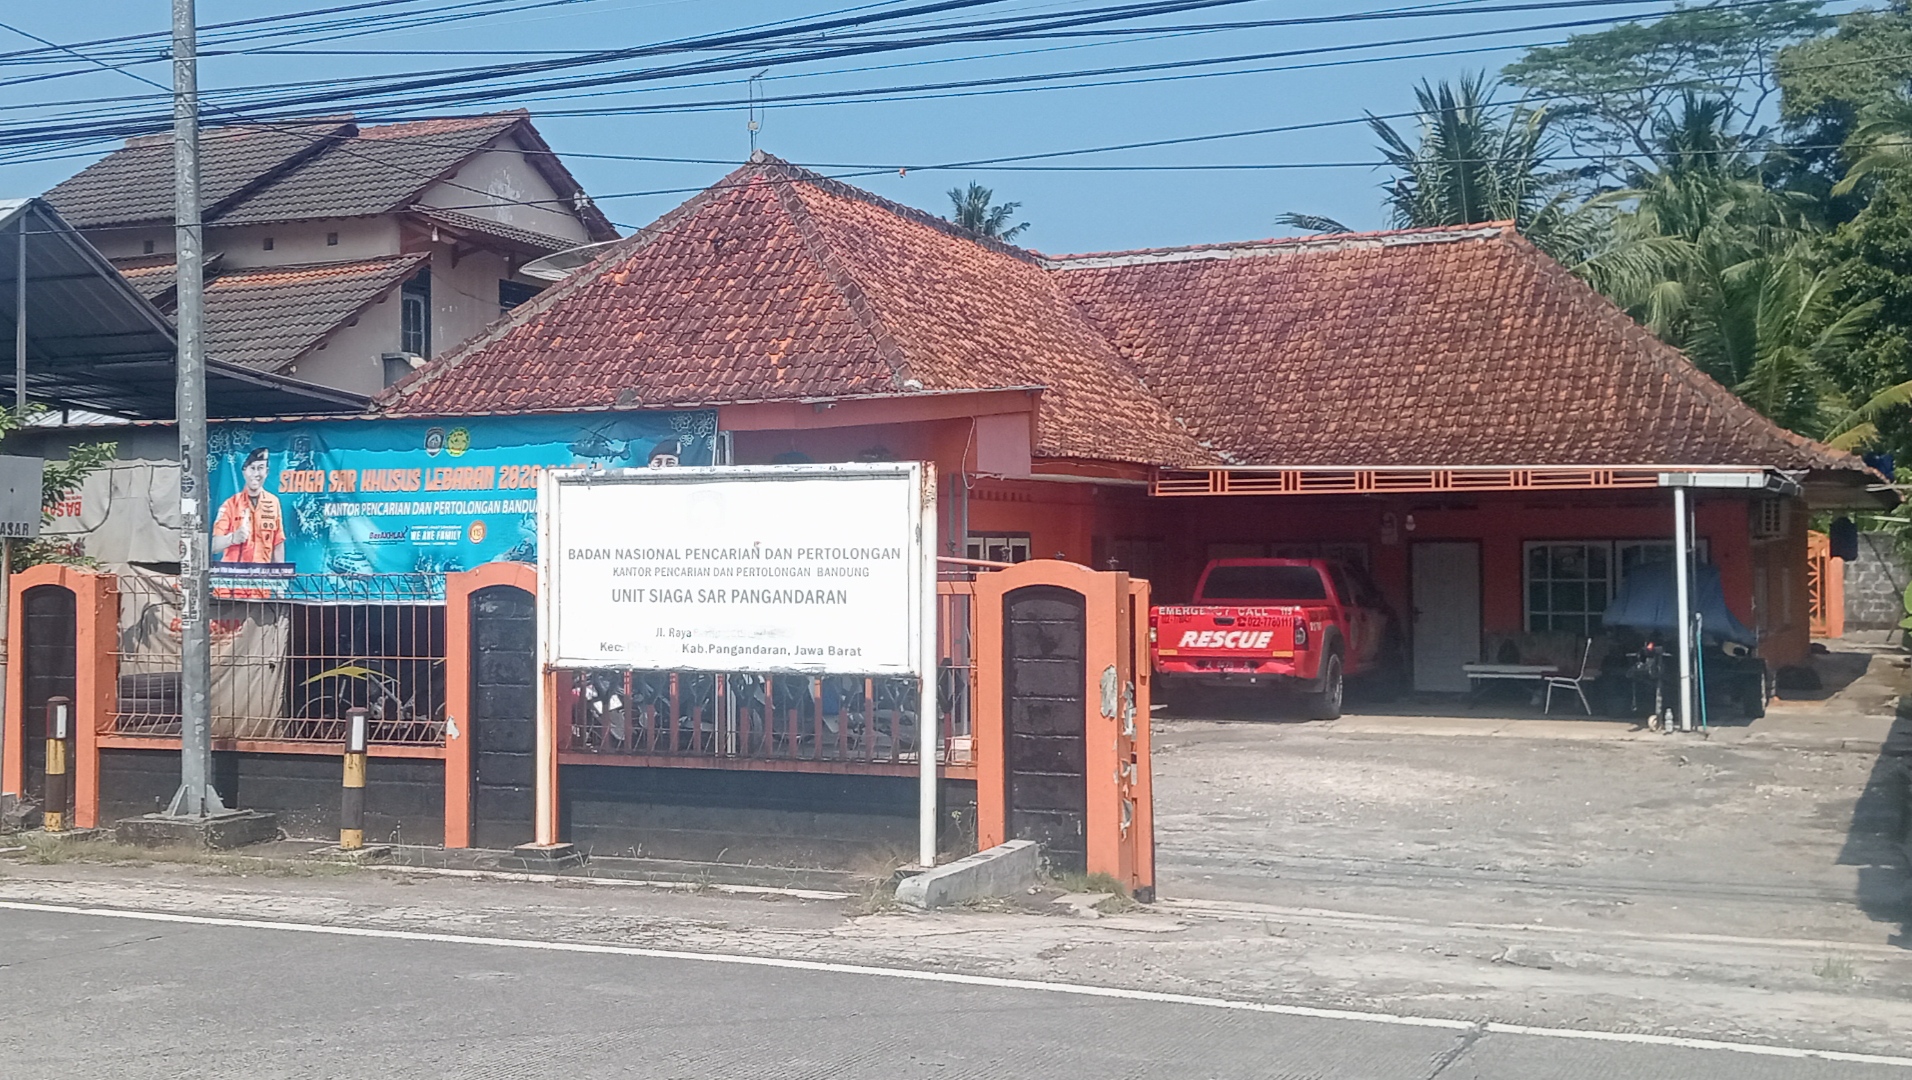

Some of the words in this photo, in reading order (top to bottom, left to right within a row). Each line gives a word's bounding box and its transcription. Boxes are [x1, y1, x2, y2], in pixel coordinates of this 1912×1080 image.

[278, 469, 325, 493] SIAGA
[328, 468, 357, 493] SAR
[360, 467, 421, 492] KHUSUS
[424, 465, 495, 492] LEBARAN
[323, 502, 360, 517] KANTOR
[361, 502, 411, 516] PENCARIAN
[411, 501, 432, 515] DAN
[433, 500, 502, 514] PERTOLONGAN
[502, 499, 538, 513] BANDU
[410, 531, 421, 541] WE
[422, 531, 436, 541] ARE
[436, 530, 462, 540] FAMILY
[568, 548, 611, 560] BADAN
[615, 548, 681, 561] NASIONAL
[685, 547, 760, 560] PENCARIAN
[765, 547, 792, 560] DAN
[797, 547, 901, 560] PERTOLONGAN
[612, 566, 652, 577] KANTOR
[654, 566, 711, 577] PENCARIAN
[713, 567, 734, 577] DAN
[736, 566, 811, 578] PERTOLONGAN
[817, 567, 870, 578] BANDUNG
[612, 588, 645, 603] UNIT
[649, 588, 694, 603] SIAGA
[697, 588, 726, 604] SAR
[731, 589, 847, 605] PANGANDARAN
[1237, 607, 1269, 616] CALL
[655, 627, 666, 638] Jl.
[668, 627, 692, 640] Raya
[1177, 630, 1274, 649] RESCUE
[794, 645, 824, 656] Jawa
[828, 645, 862, 657] Barat
